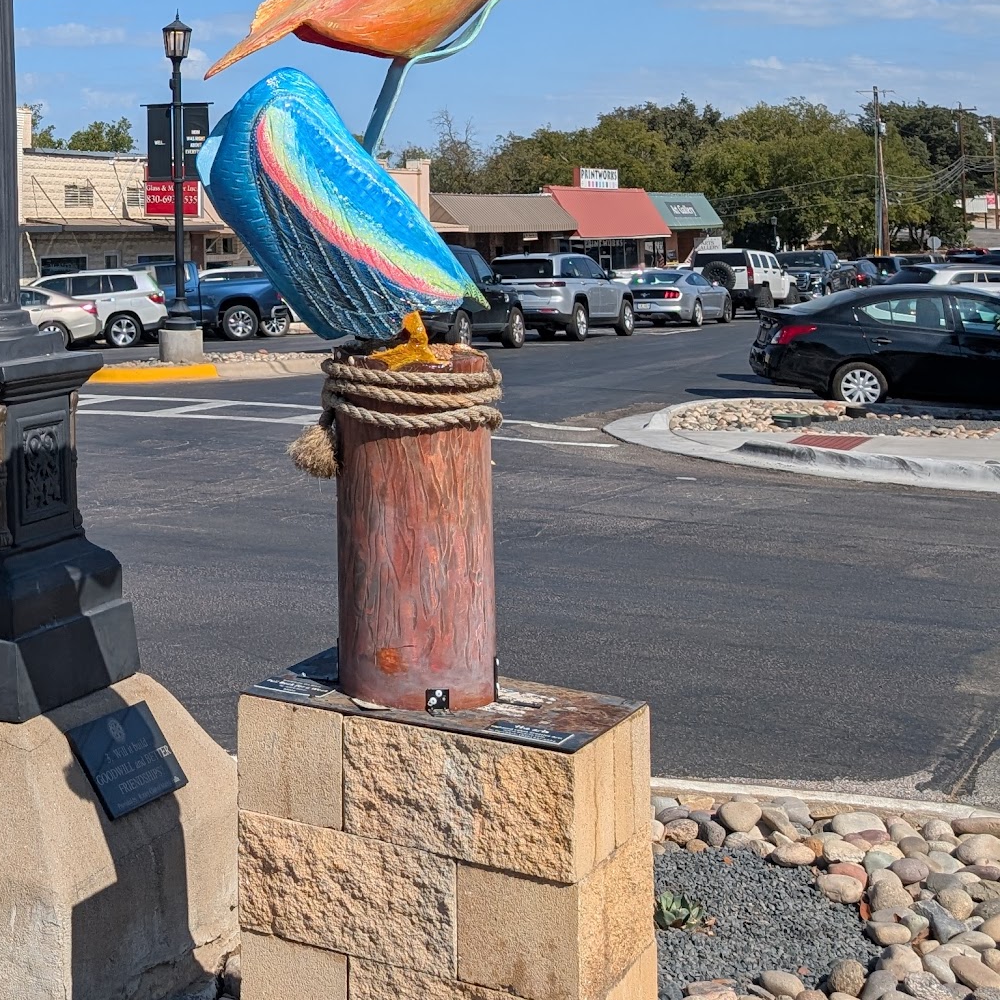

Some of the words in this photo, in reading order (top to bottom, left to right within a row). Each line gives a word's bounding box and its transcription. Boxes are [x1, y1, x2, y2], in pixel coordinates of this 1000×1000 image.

[581, 169, 618, 180] PRINTWORKS
[146, 184, 160, 192] Glass
[161, 184, 168, 192] &
[113, 746, 127, 759] Will
[127, 745, 133, 754] it
[132, 738, 149, 753] build
[95, 762, 136, 786] GOODWILL
[135, 756, 147, 769] and
[144, 745, 172, 765] BETTER
